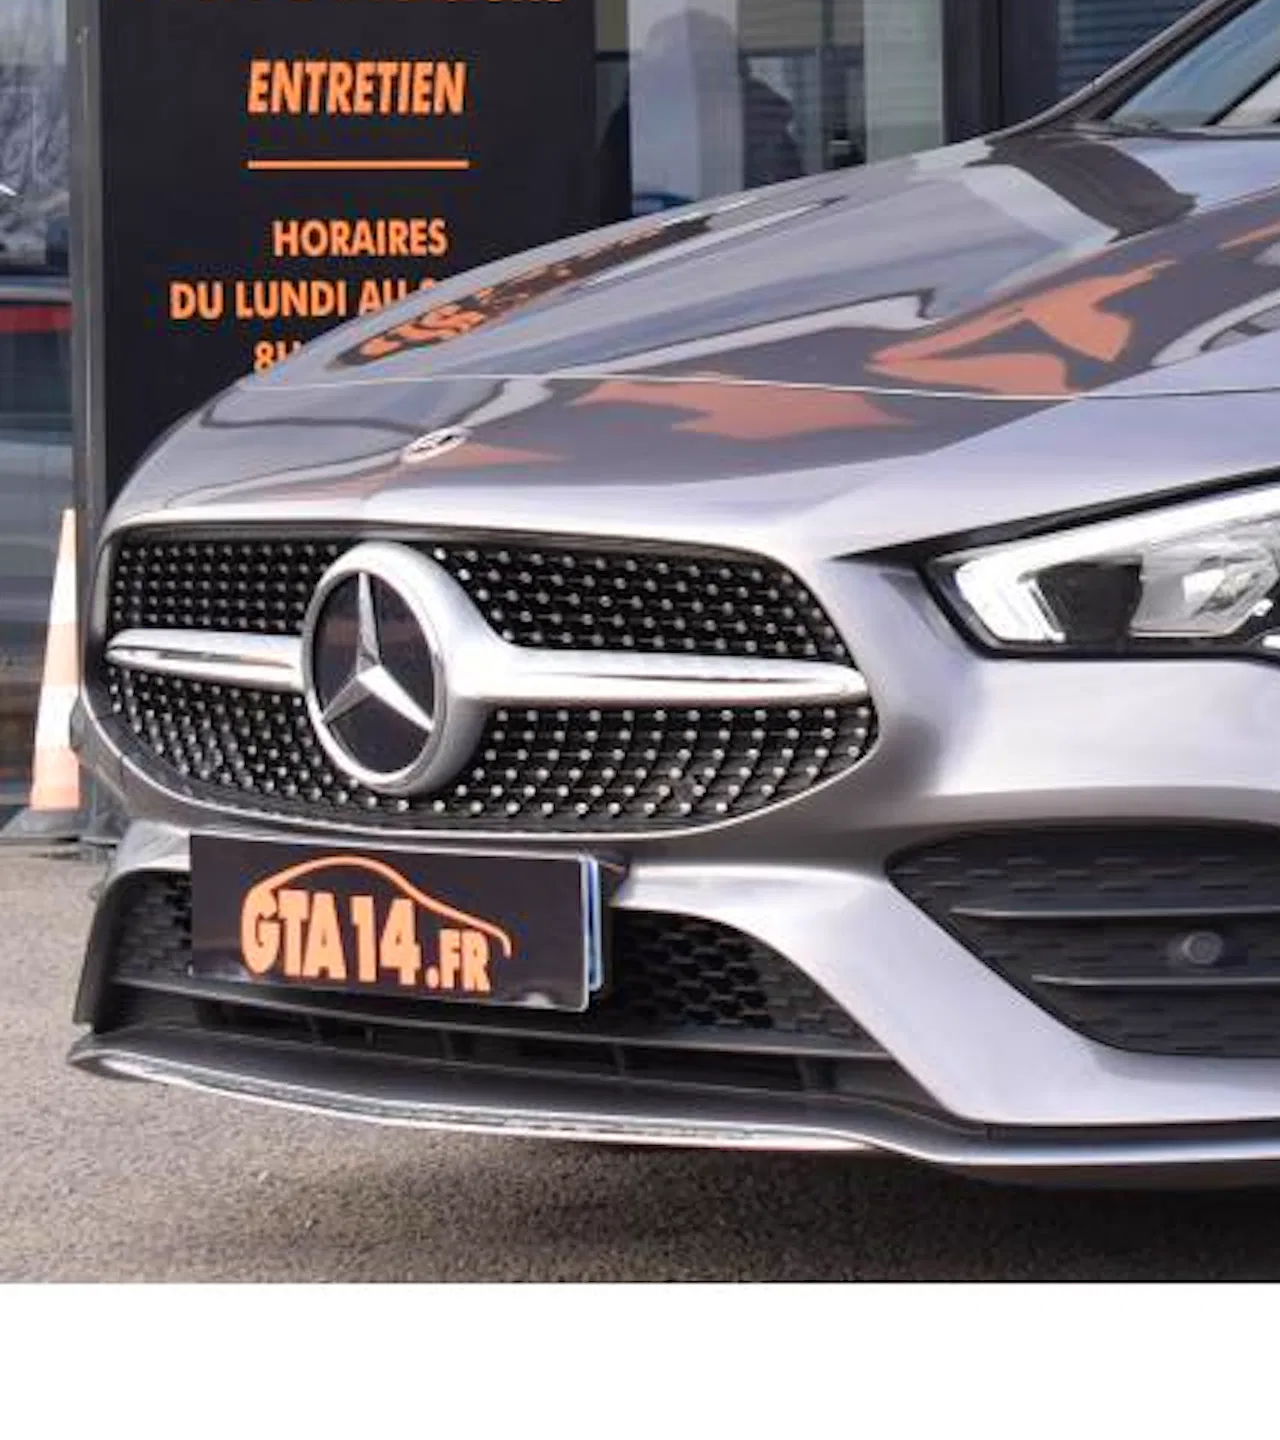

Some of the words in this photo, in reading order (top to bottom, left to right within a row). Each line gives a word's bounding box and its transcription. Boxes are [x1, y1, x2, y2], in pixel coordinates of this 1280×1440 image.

[247, 60, 466, 115] ENTRETIEN
[273, 218, 448, 257] HORAIRES
[170, 281, 224, 320] DU
[235, 279, 347, 319] LUNDI
